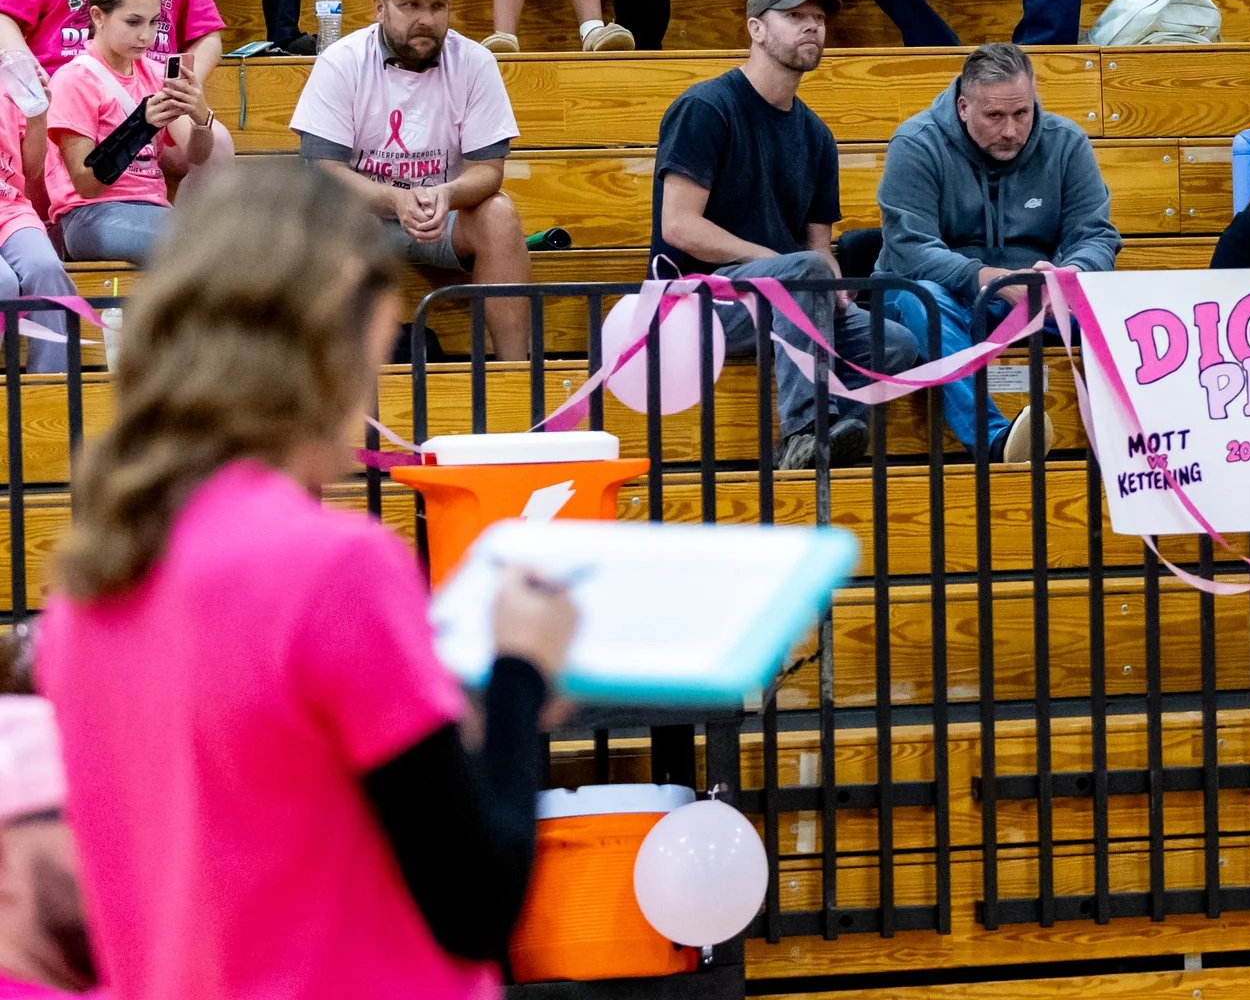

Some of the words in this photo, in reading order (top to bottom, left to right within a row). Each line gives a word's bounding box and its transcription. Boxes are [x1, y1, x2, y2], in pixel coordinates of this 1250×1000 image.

[364, 157, 393, 178] DIG
[400, 159, 441, 179] PINK
[1128, 429, 1190, 458] MOTT
